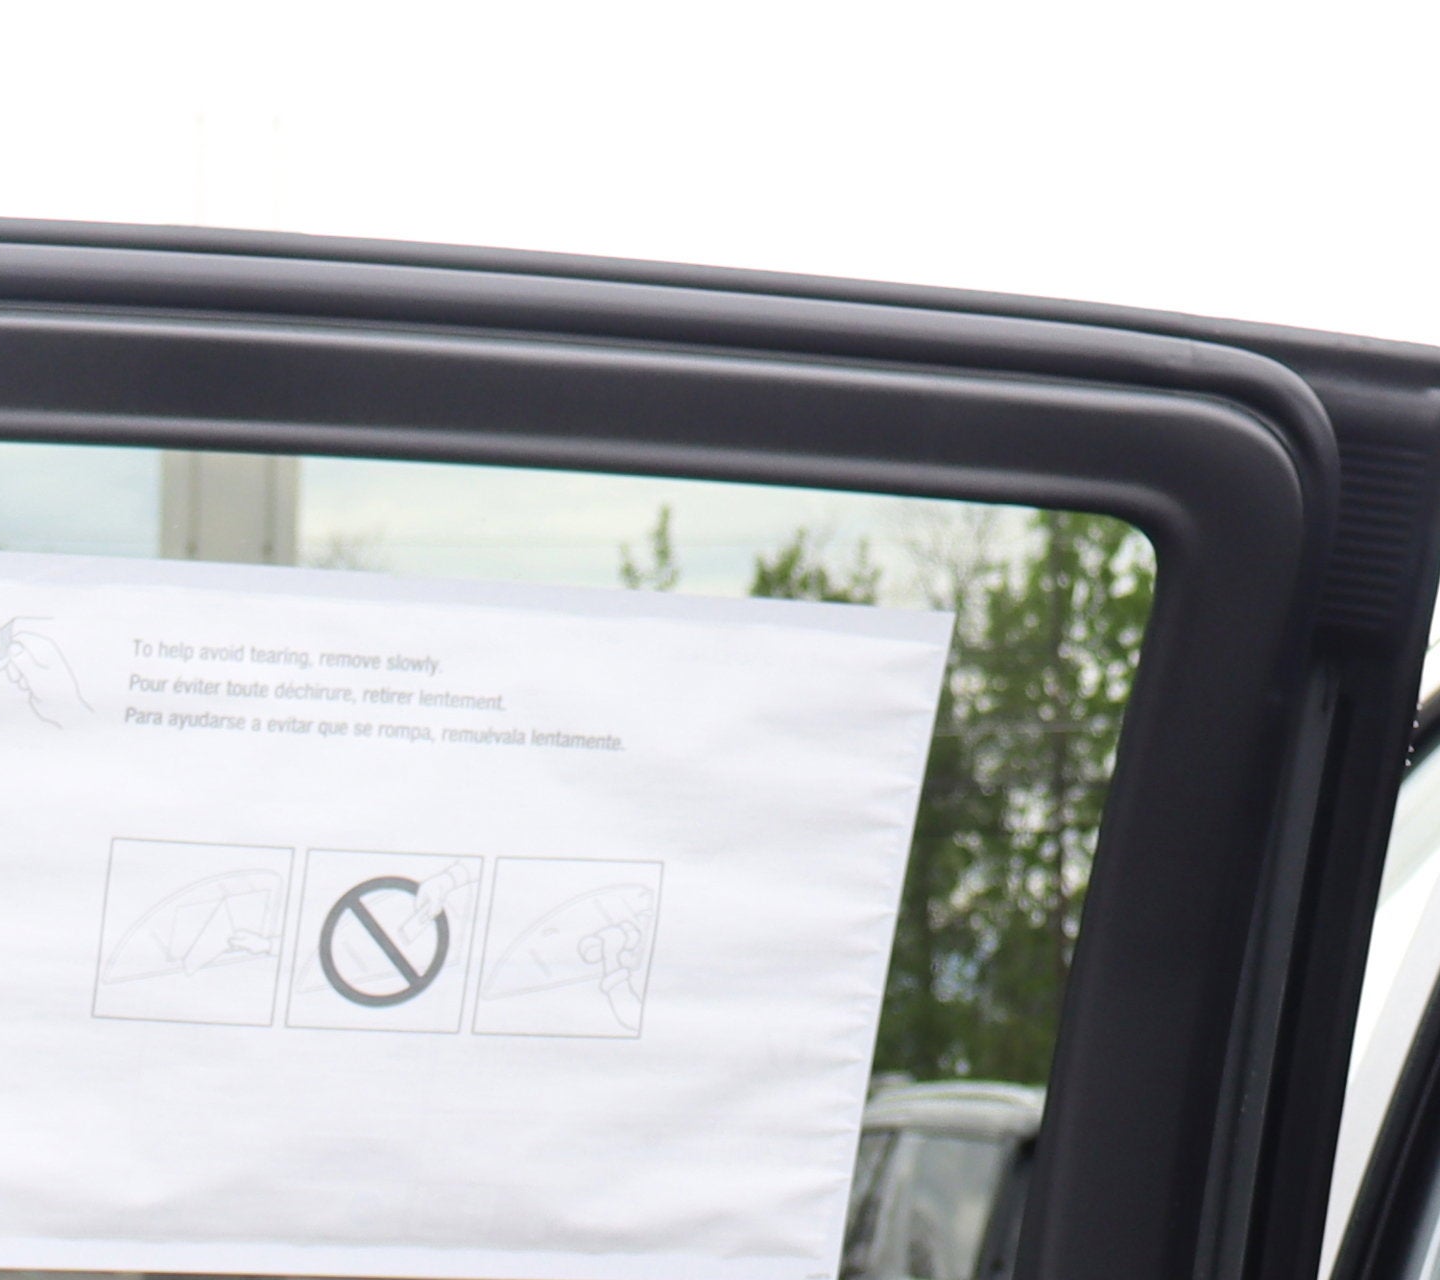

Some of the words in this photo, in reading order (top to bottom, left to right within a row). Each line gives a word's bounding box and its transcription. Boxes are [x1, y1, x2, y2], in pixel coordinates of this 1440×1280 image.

[133, 639, 153, 657] To
[158, 641, 194, 663] help
[200, 644, 244, 662] avoid
[319, 653, 381, 670] remove
[387, 654, 444, 676] slowly.
[129, 673, 168, 692] Pour
[173, 676, 221, 697] éviter
[227, 681, 270, 699] toute
[275, 683, 357, 704] déchirure,
[363, 687, 414, 706] retirer
[124, 707, 162, 725] Para
[168, 711, 246, 730] ayudarse
[251, 717, 261, 731] a
[267, 716, 313, 734] evitar
[318, 720, 349, 738] que
[354, 722, 372, 737] se
[378, 723, 435, 743] rompa,
[442, 726, 526, 746] remuévala
[530, 729, 626, 751] lentamente.
